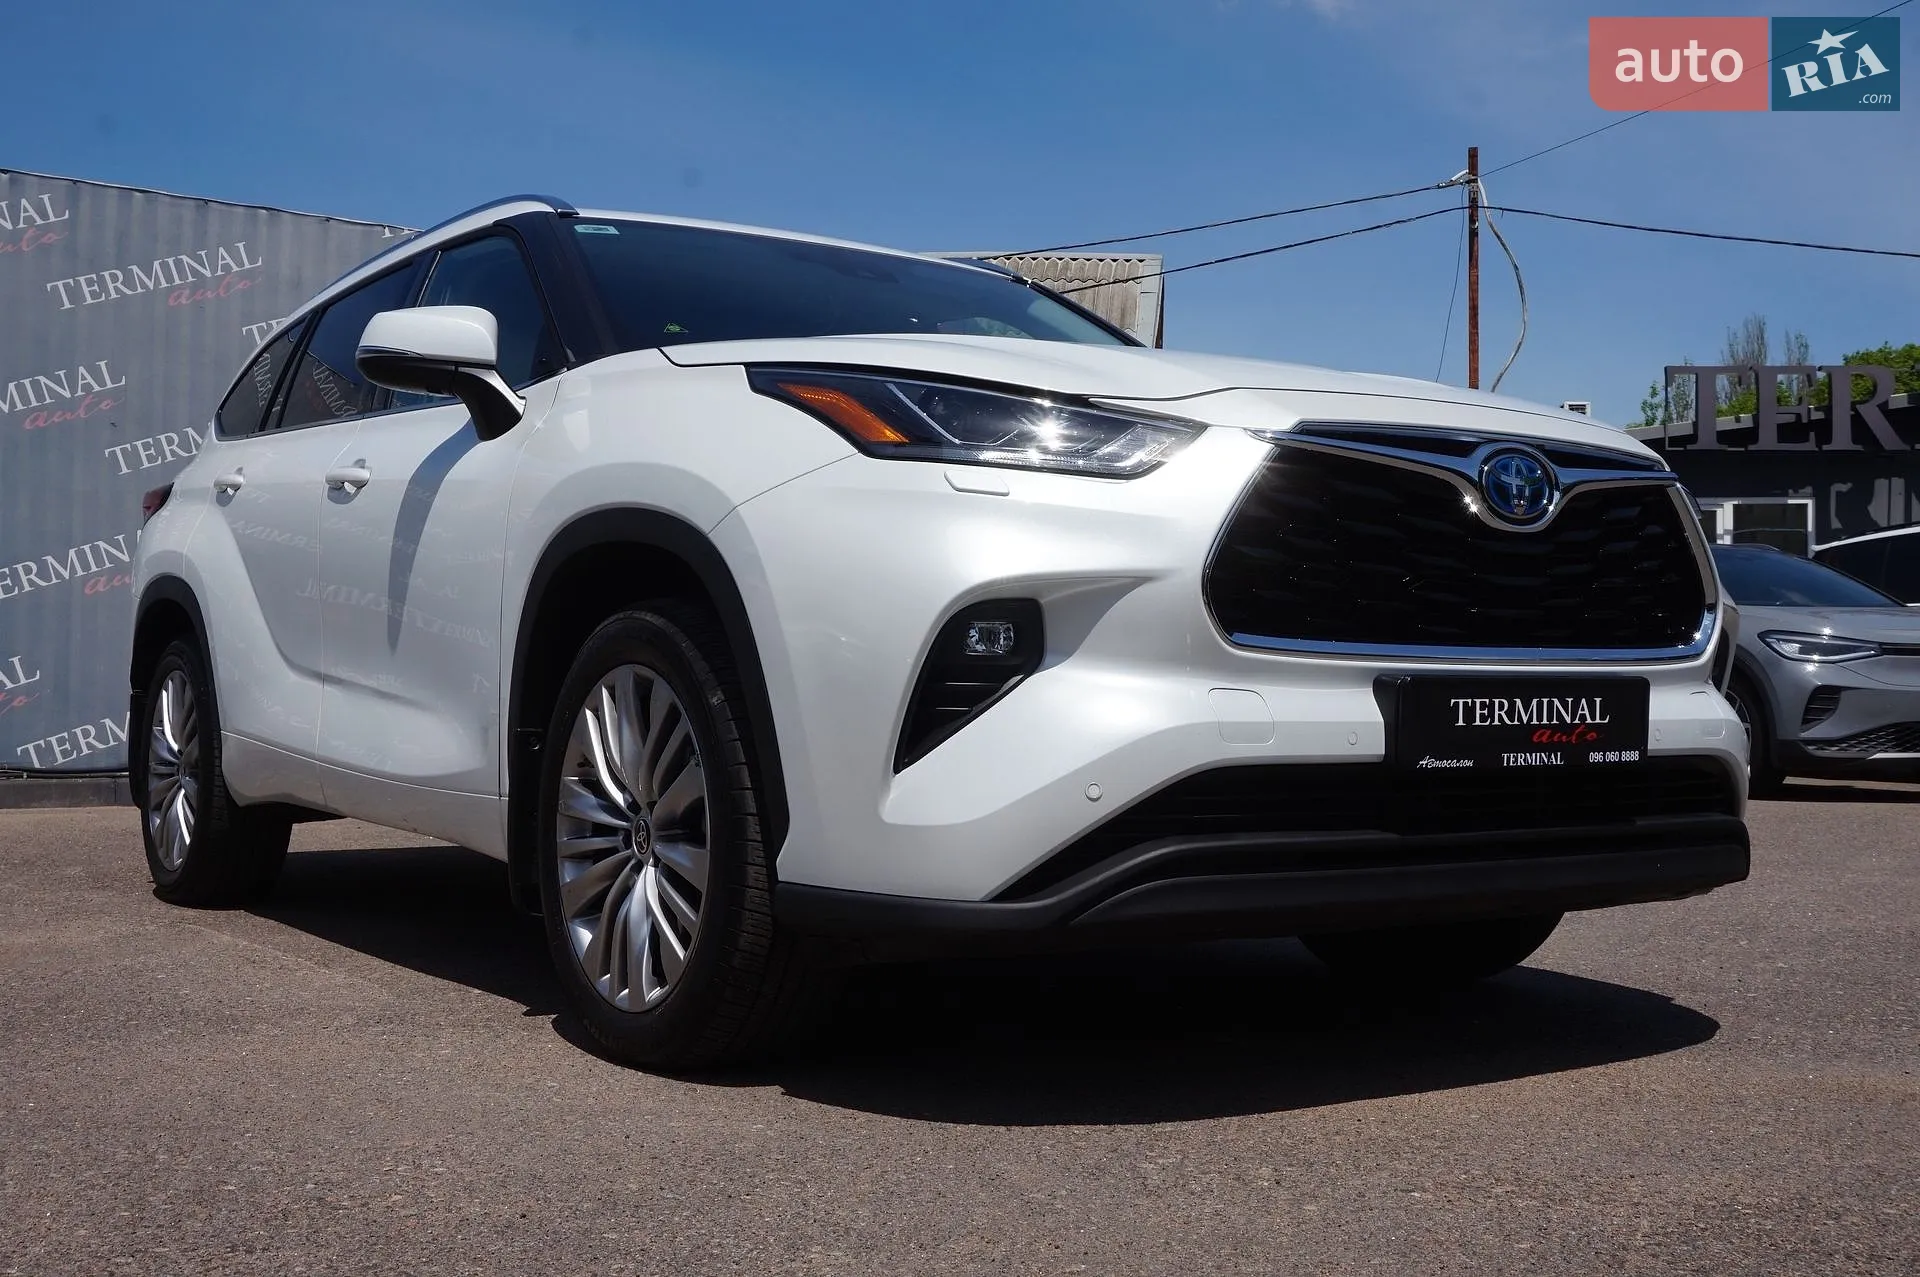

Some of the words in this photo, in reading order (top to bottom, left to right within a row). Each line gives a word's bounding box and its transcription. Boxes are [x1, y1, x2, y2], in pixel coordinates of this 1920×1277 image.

[47, 241, 263, 311] TERMINAL
[167, 274, 262, 307] auto
[0, 360, 126, 414] MINAL
[23, 394, 125, 430] auto
[1664, 364, 1920, 450] TER
[0, 529, 141, 600] ERMIN
[1450, 697, 1611, 727] TERMINAL
[1532, 723, 1603, 744] auto
[1501, 752, 1565, 767] TERMINAL
[1589, 751, 1604, 763] 096
[1605, 751, 1620, 762] 060
[1621, 750, 1640, 762] 8888
